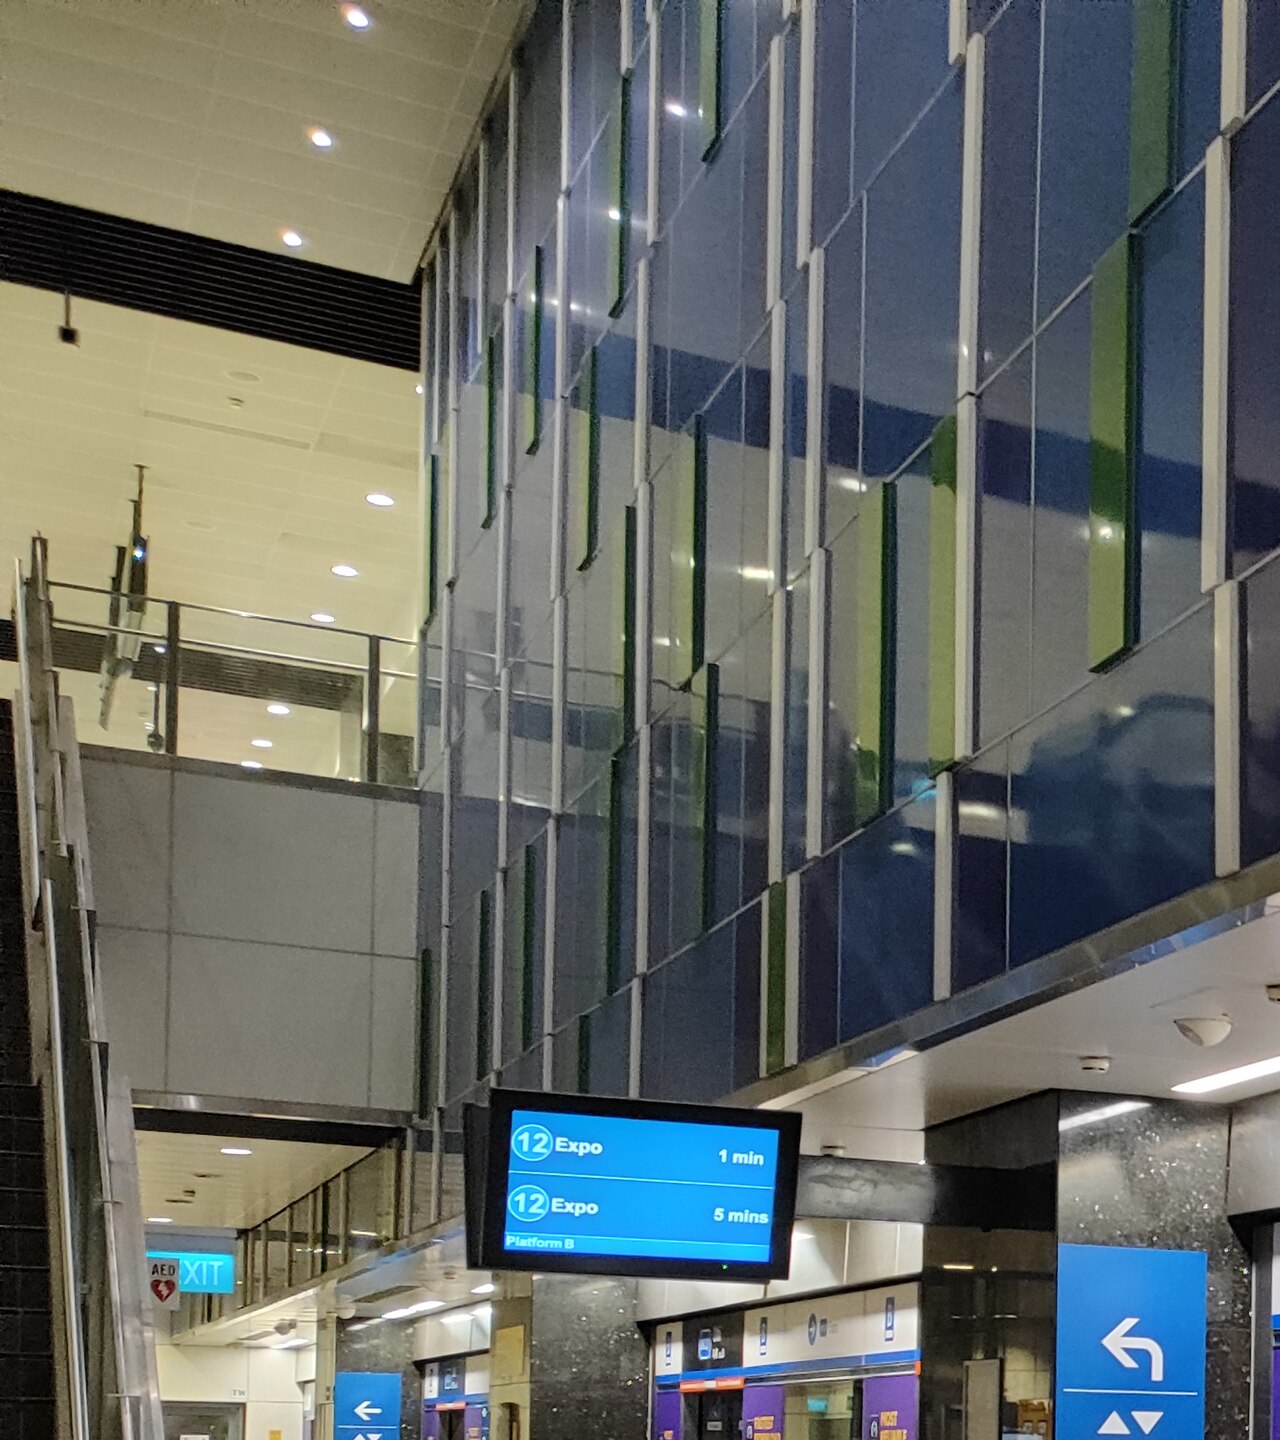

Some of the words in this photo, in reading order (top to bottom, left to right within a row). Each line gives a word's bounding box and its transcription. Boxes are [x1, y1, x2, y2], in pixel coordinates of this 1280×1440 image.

[517, 1132, 548, 1153] 12
[555, 1137, 603, 1157] Expo
[718, 1149, 727, 1163] 1
[732, 1151, 764, 1166] min
[513, 1192, 544, 1213] 12
[551, 1198, 599, 1217] Expo
[713, 1208, 724, 1222] 5
[728, 1209, 769, 1224] mins
[505, 1234, 561, 1249] Platform
[564, 1239, 574, 1249] B
[152, 1264, 175, 1276] AED
[182, 1260, 224, 1286] XIT
